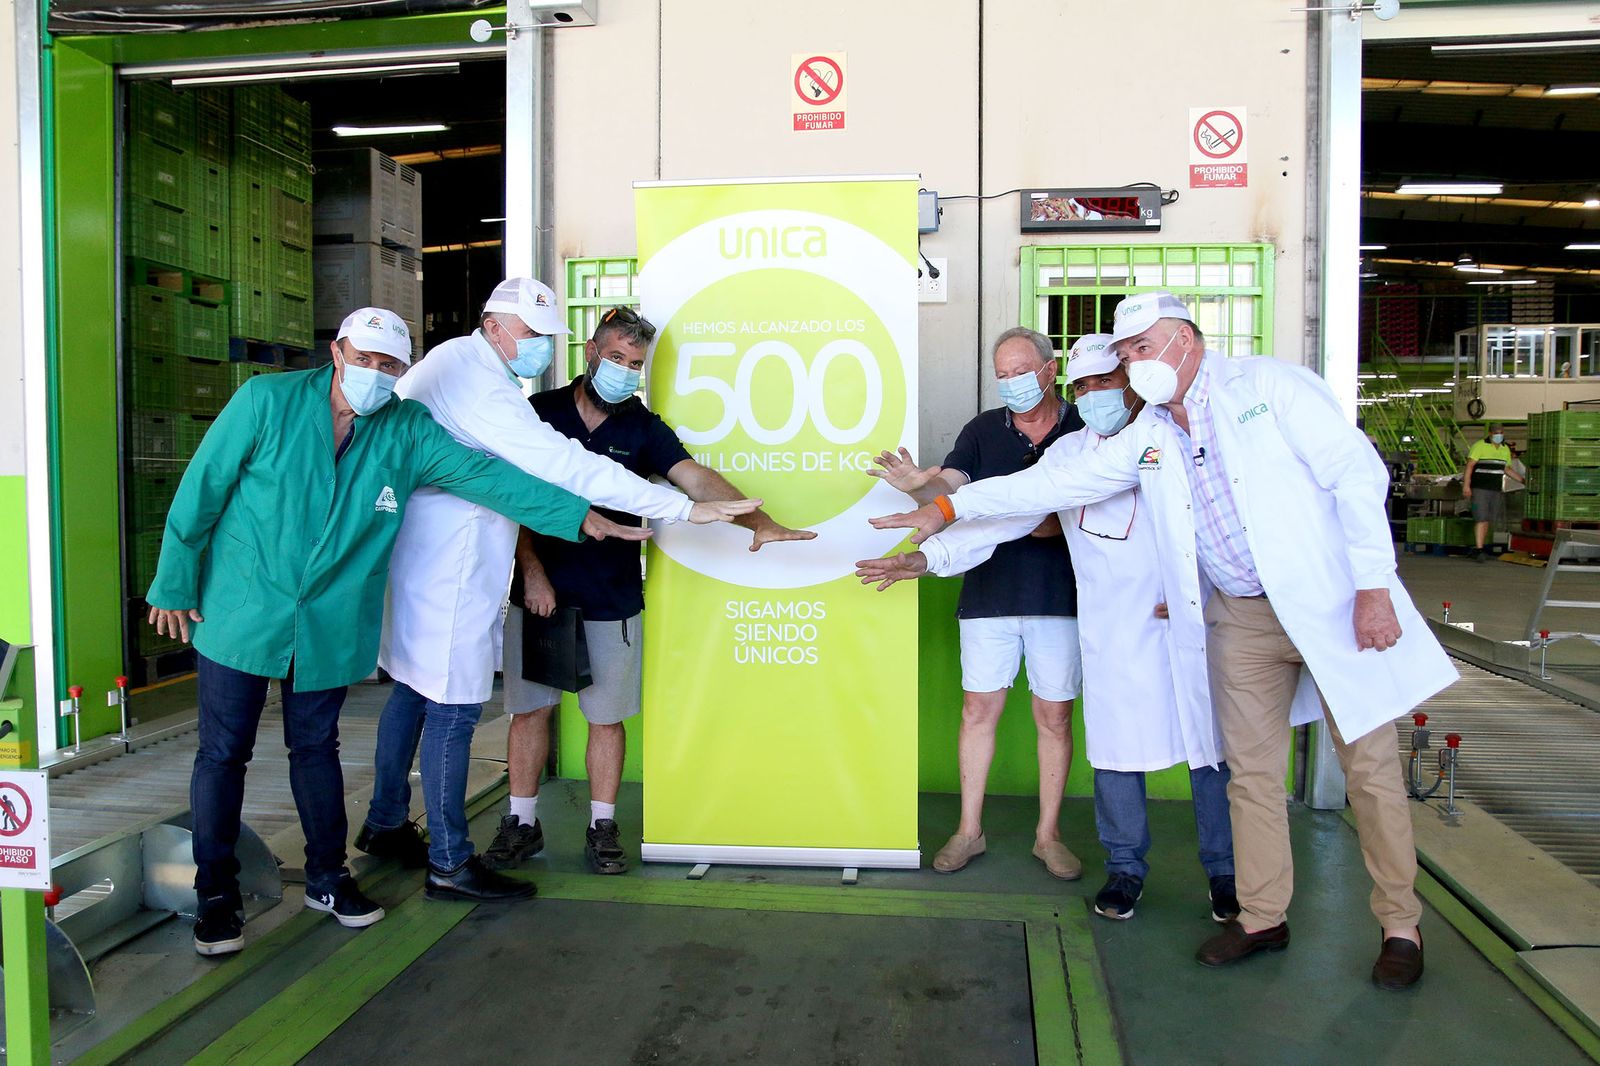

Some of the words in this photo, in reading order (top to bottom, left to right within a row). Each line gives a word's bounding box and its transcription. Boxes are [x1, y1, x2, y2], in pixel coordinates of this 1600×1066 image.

[796, 113, 842, 121] PROHIBIDO
[805, 121, 834, 129] FUMAR
[1194, 166, 1243, 174] PROHIBIDO
[1203, 173, 1237, 181] FUMAR
[1140, 207, 1153, 218] kg
[719, 225, 828, 260] unica
[682, 321, 737, 335] HEMOS
[739, 320, 833, 334] ALCANZADO
[836, 319, 866, 333] LOS
[674, 338, 883, 446] 500
[1237, 403, 1269, 424] unica
[801, 452, 833, 473] DE
[839, 451, 872, 473] KG
[725, 600, 827, 620] SIGAMOS
[734, 623, 818, 642] SIENDO
[734, 641, 819, 665] ÚNICOS
[4, 855, 29, 864] PASO
